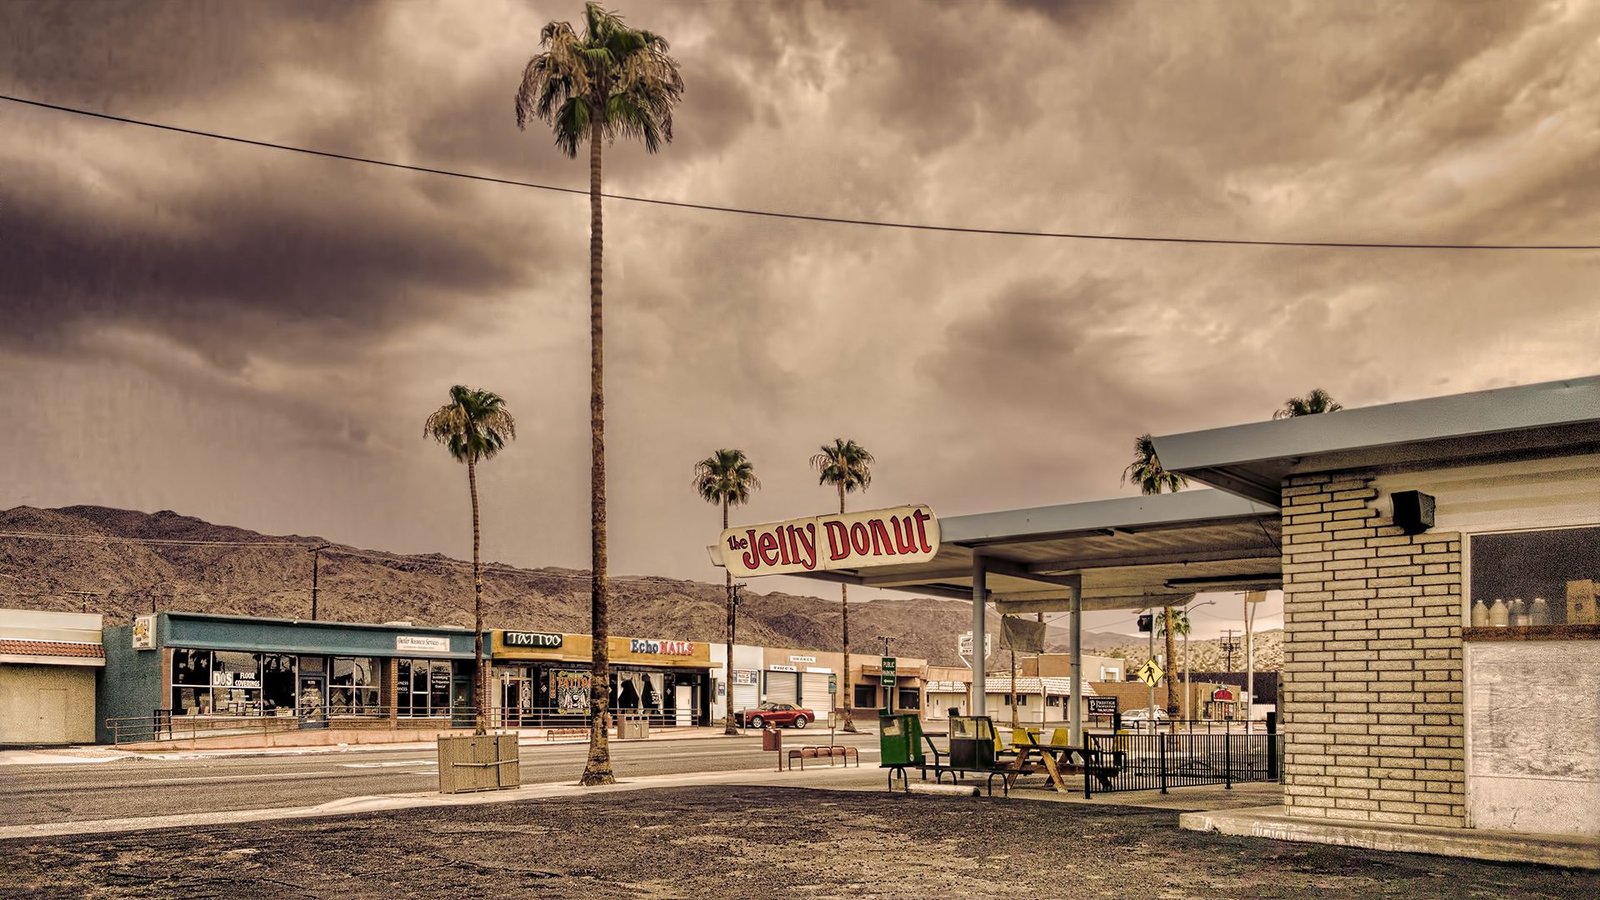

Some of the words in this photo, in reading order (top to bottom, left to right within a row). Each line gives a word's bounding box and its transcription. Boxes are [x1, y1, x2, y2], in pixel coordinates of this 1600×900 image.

[727, 535, 748, 550] the
[742, 523, 817, 570] Jelly
[823, 508, 933, 562] Donut
[507, 632, 561, 645] TATTOO
[631, 639, 659, 654] Echo
[660, 640, 694, 656] NAILS
